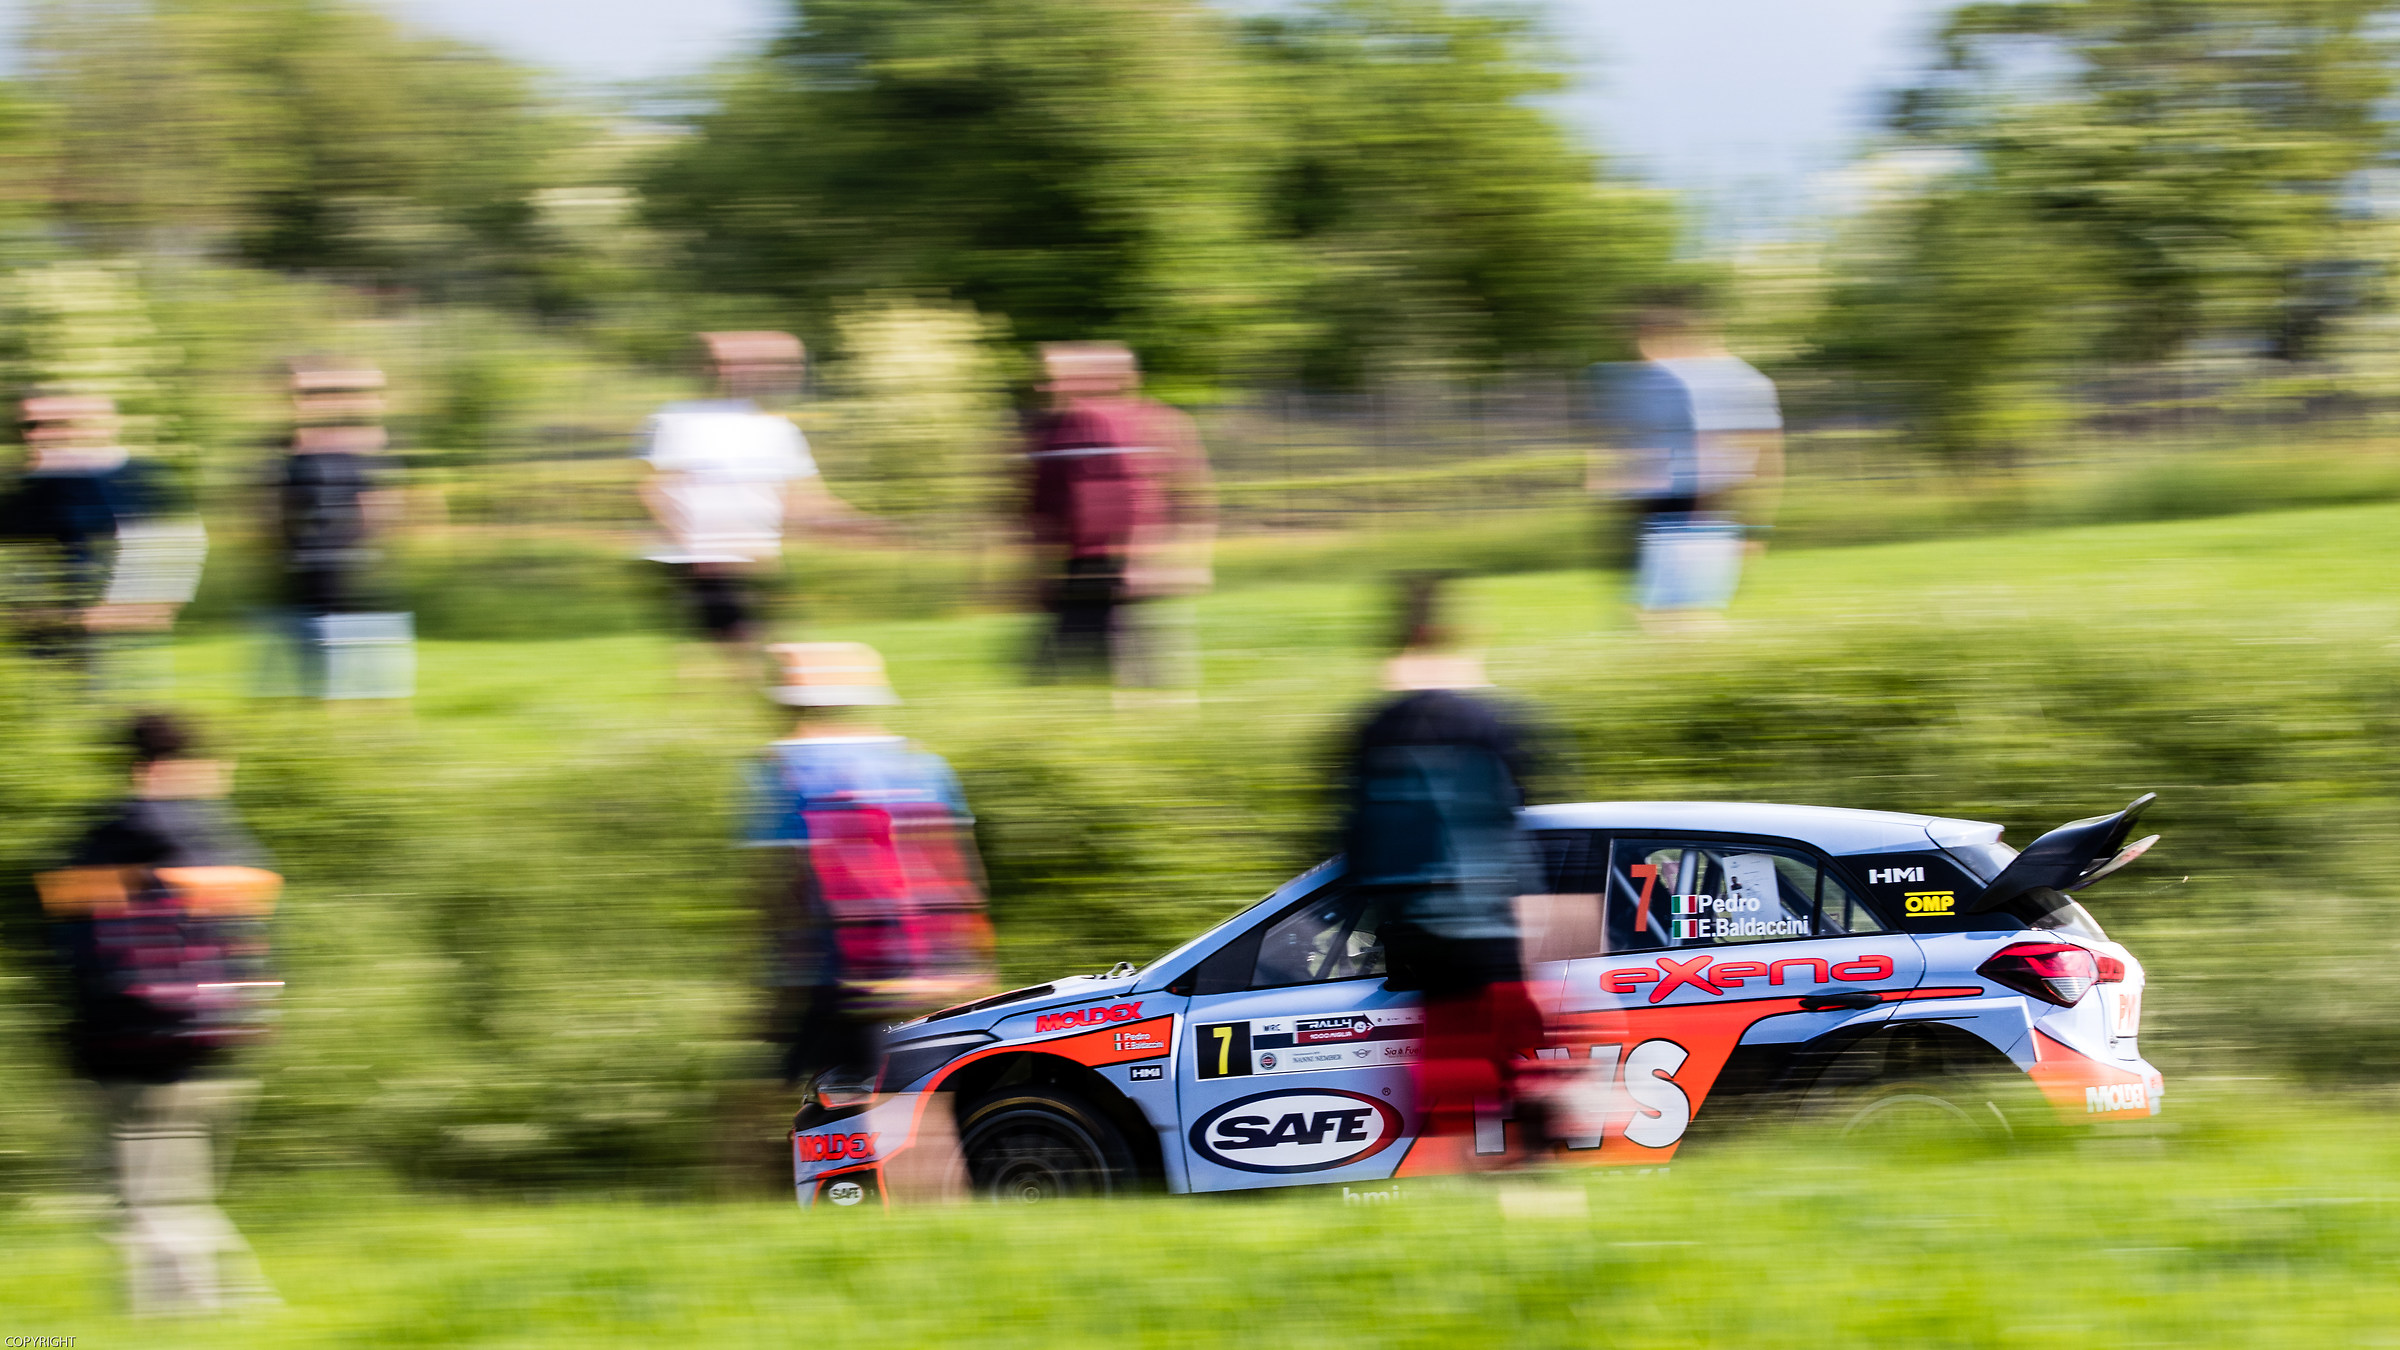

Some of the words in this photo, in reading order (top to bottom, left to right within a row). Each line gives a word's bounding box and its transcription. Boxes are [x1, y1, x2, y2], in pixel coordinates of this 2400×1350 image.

[1868, 866, 1926, 884] HMI
[1630, 864, 1658, 932] 7
[1698, 894, 1761, 913] Pedro
[1904, 895, 1955, 912] OMP
[1698, 915, 1809, 938] E.Baldaccini
[1035, 1001, 1144, 1033] MOLDEX
[1213, 1026, 1233, 1075] 7
[1213, 1107, 1373, 1150] SAFE
